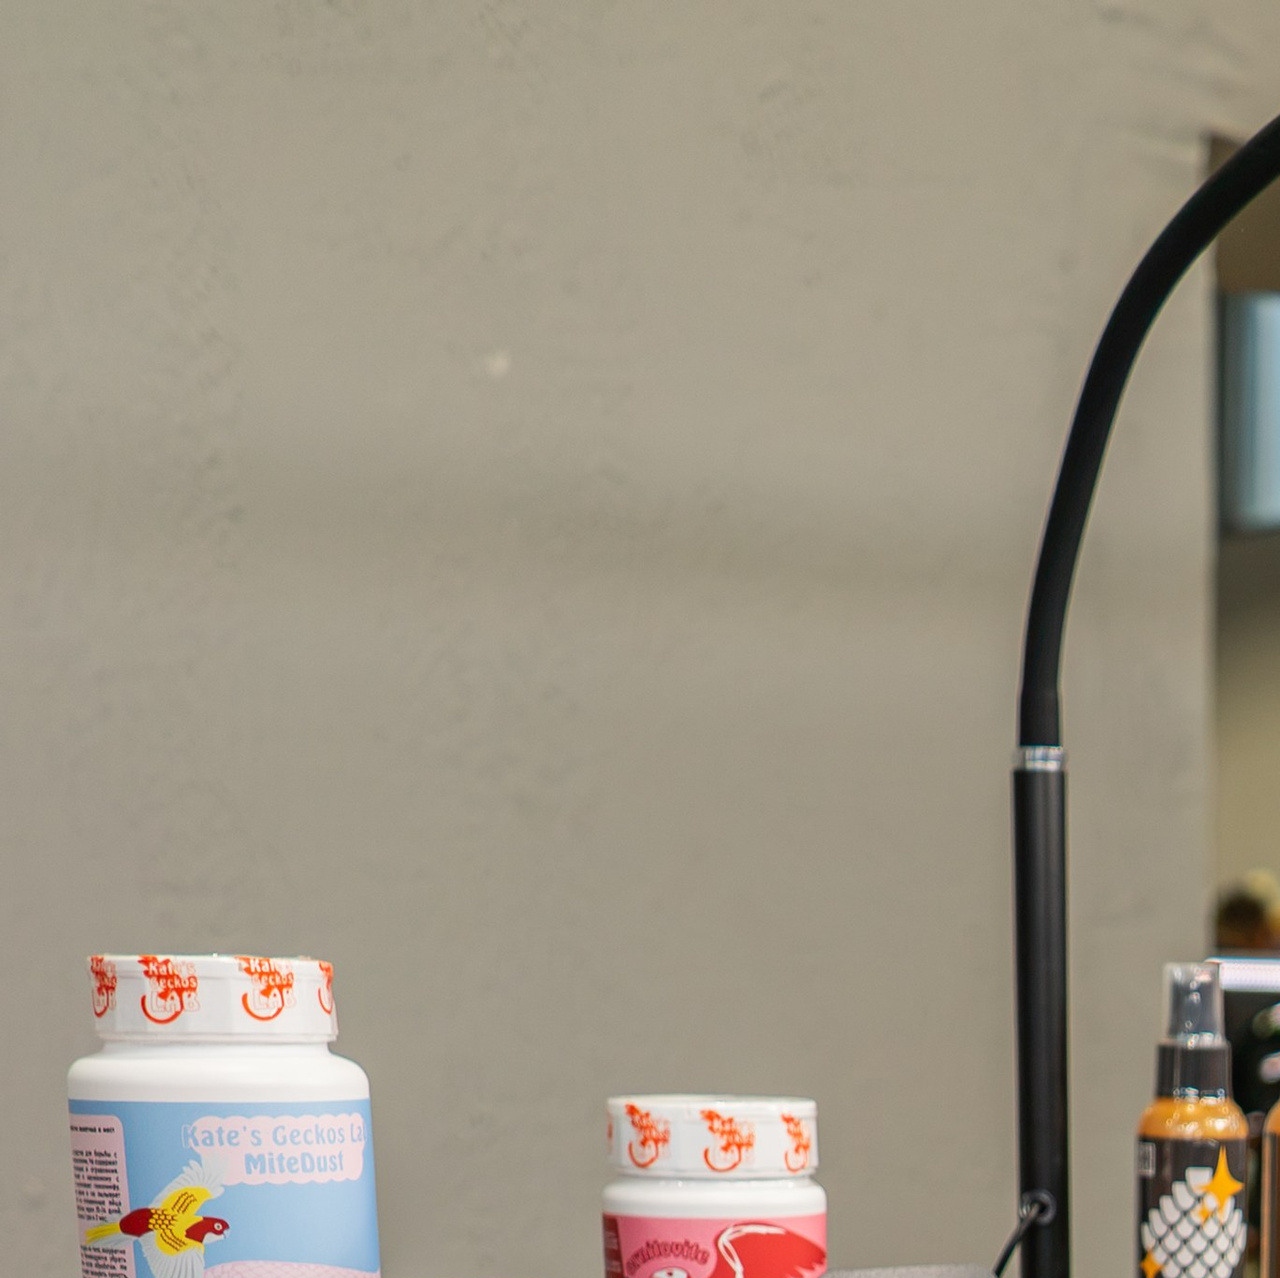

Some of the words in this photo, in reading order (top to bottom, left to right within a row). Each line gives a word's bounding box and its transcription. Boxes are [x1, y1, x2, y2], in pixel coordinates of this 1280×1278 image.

[182, 1124, 262, 1149] Kate's
[271, 1122, 345, 1147] Geckos
[244, 1151, 345, 1177] MiteDust
